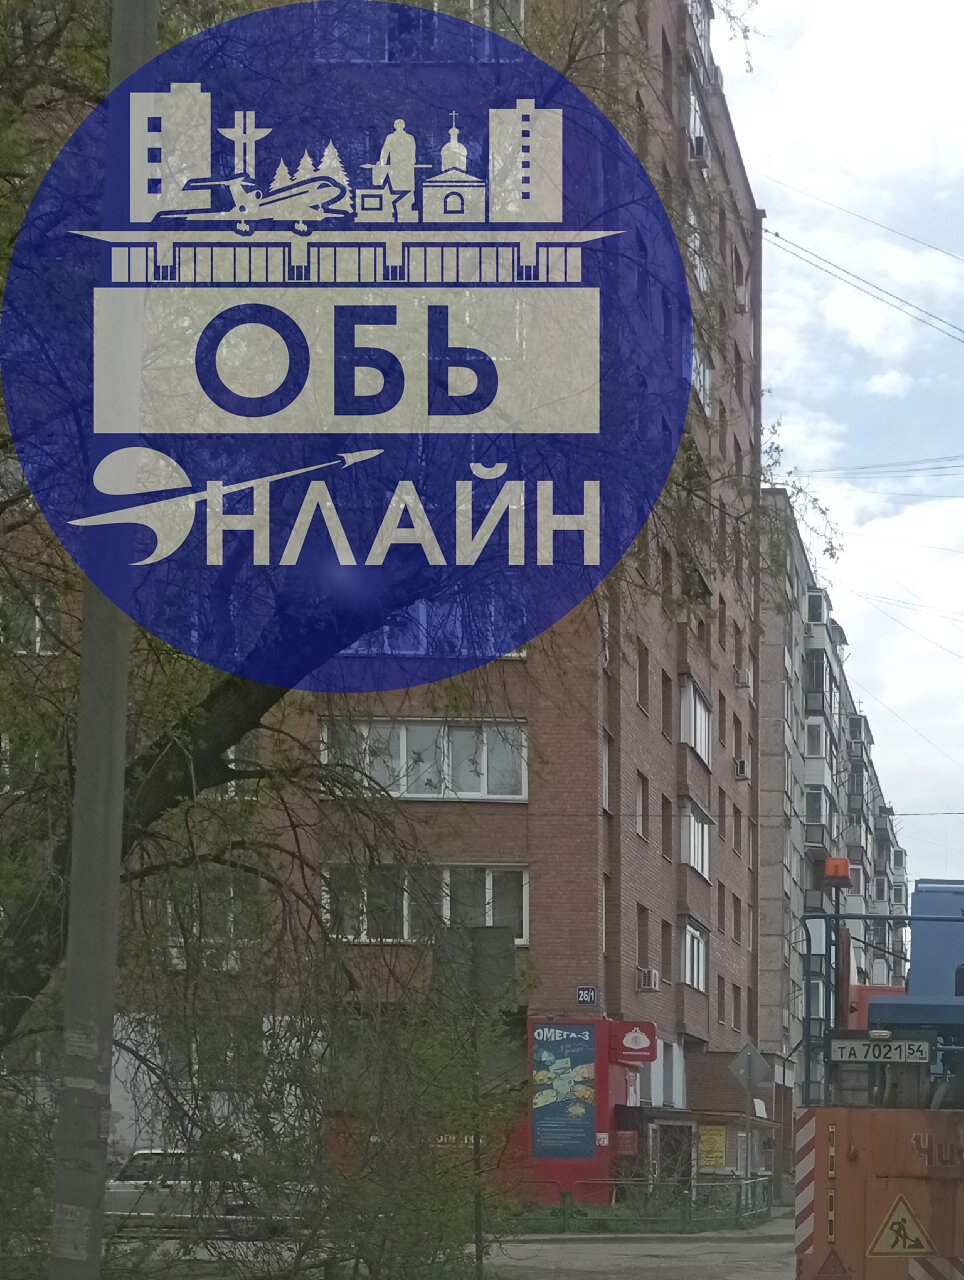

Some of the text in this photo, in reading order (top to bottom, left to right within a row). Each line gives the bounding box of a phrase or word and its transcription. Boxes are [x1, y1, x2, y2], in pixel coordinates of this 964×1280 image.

[578, 988, 595, 1002] 26/1
[533, 1028, 590, 1041] ОМЕГА-3
[862, 1043, 903, 1060] 7021
[907, 1043, 924, 1056] 54
